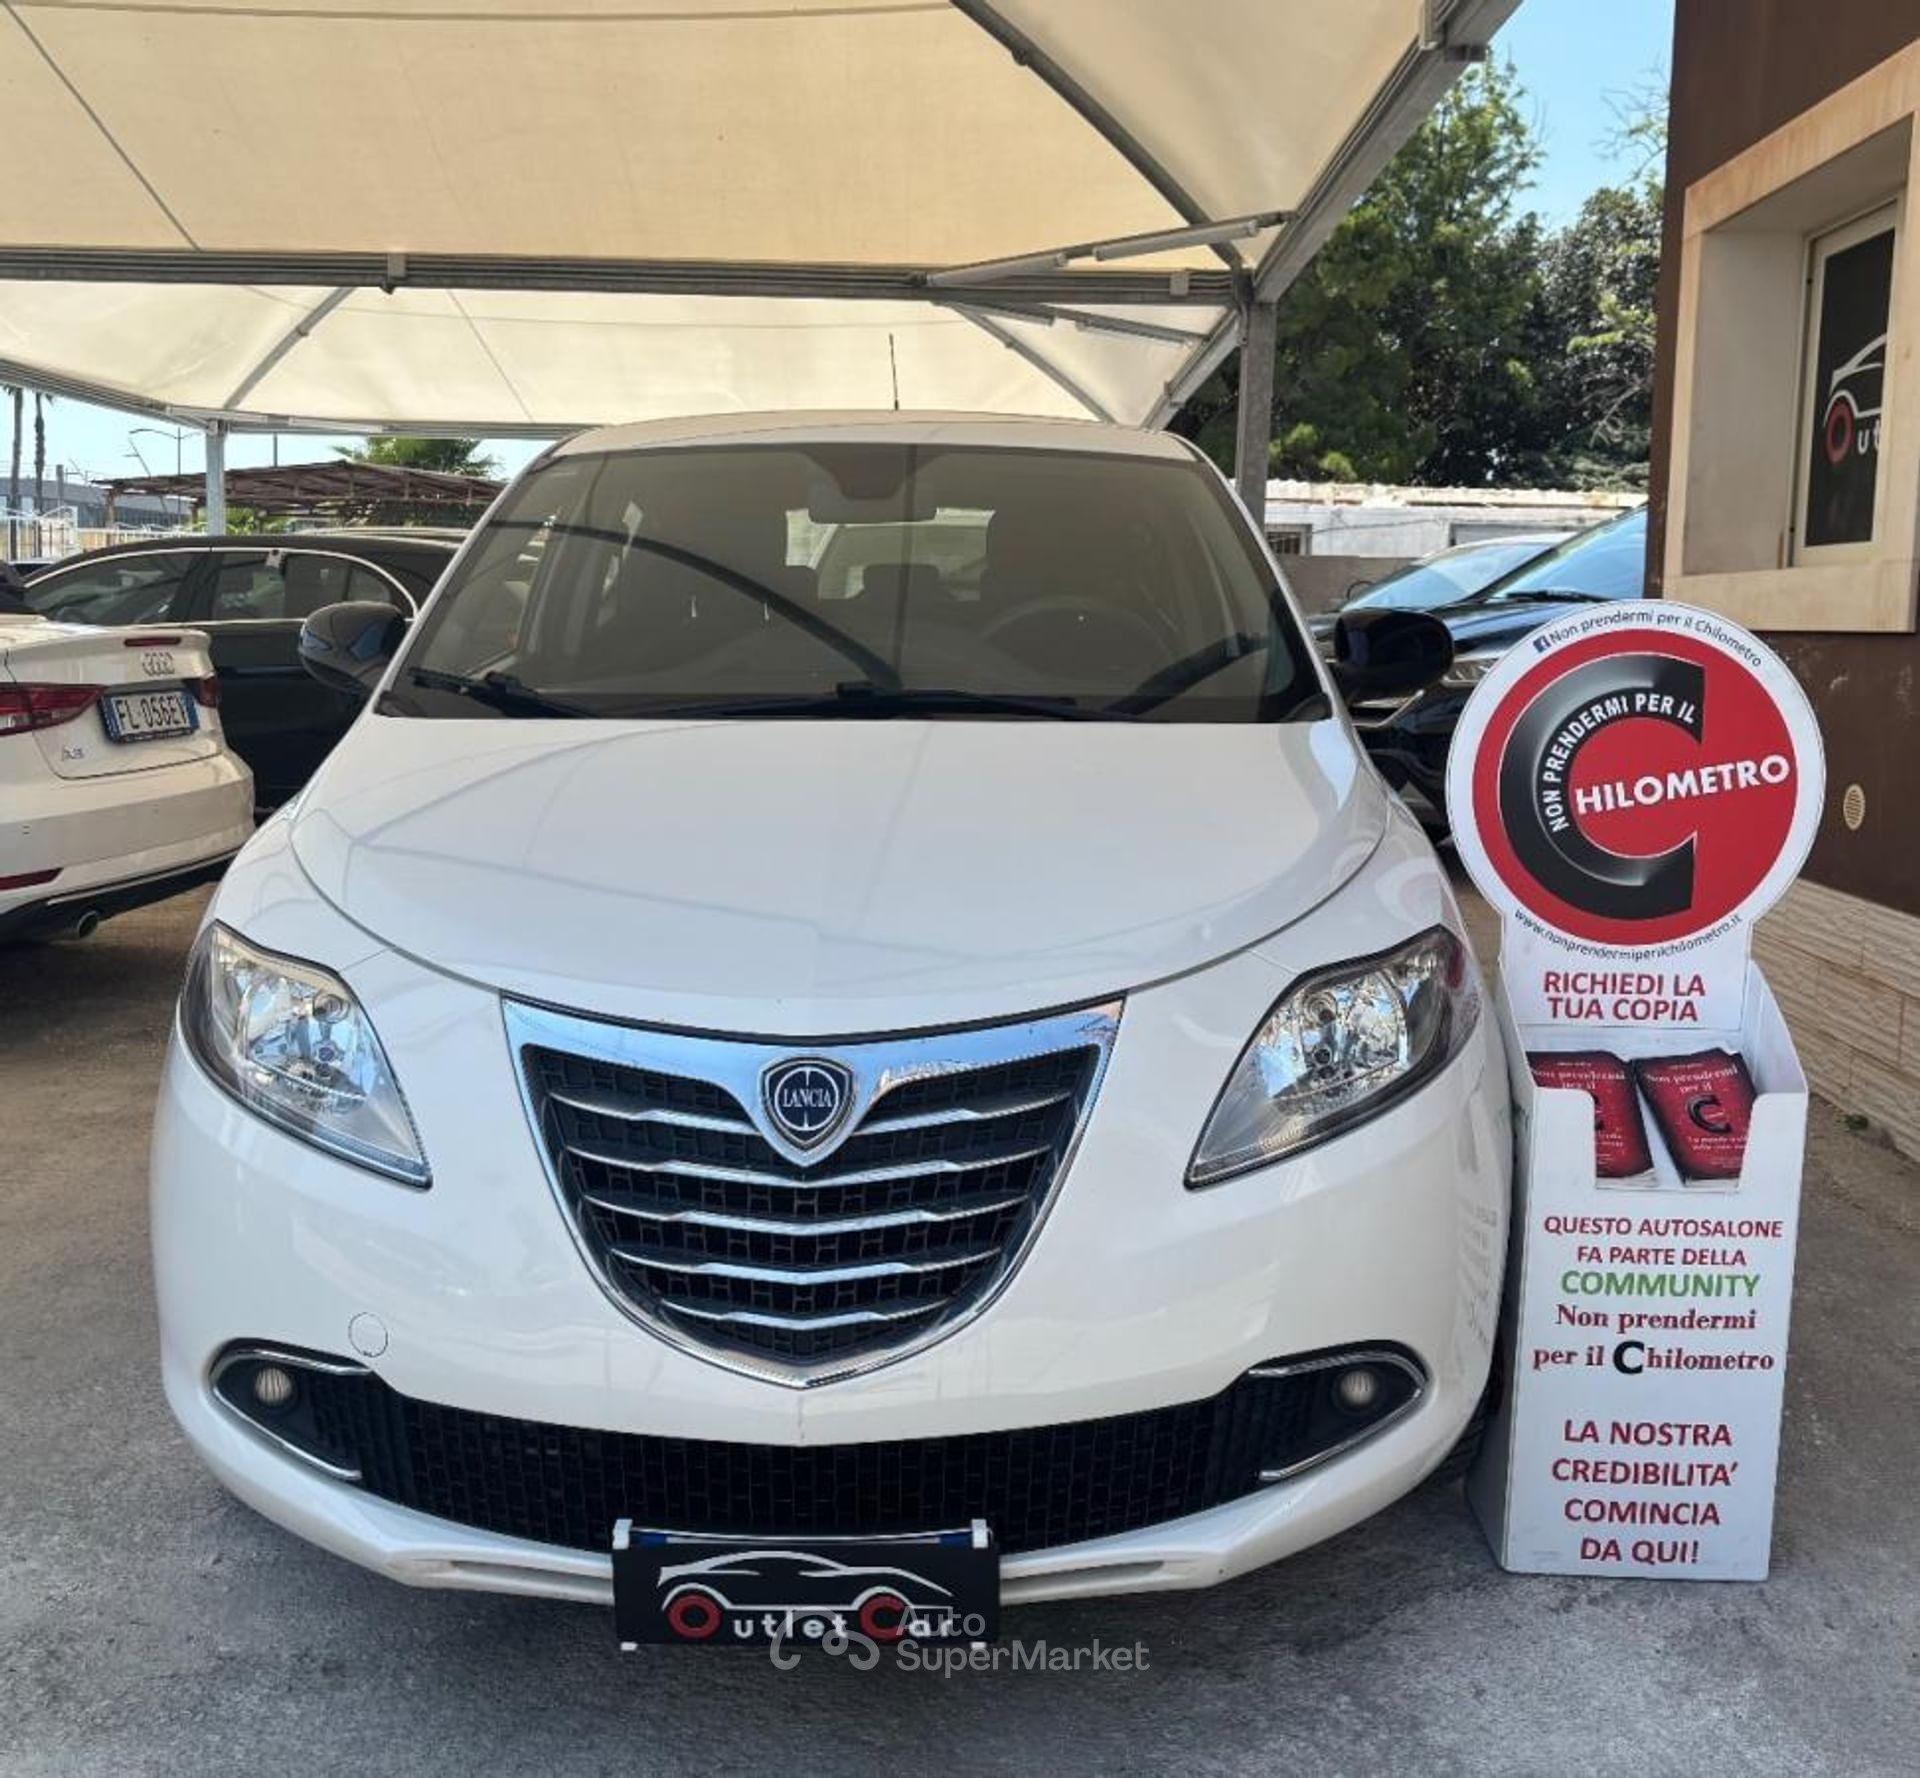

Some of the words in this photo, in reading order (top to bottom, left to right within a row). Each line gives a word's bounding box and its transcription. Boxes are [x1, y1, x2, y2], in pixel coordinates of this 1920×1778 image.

[1550, 626, 1585, 645] Non
[1581, 610, 1654, 633] prendermi
[1657, 613, 1680, 626] per
[1684, 616, 1694, 628] il
[1694, 619, 1762, 667] Chilometro
[114, 698, 141, 731] FL
[1635, 692, 1674, 716] PER
[1677, 701, 1696, 724] IL
[1543, 695, 1629, 783] PRENDERMI
[1543, 789, 1570, 833] NON
[1543, 971, 1665, 997] RICHIEDI
[1673, 974, 1706, 997] LA
[1547, 997, 1604, 1020] TUA
[1612, 999, 1699, 1022] COPIA
[782, 1087, 832, 1108] LANCIA
[1543, 1215, 1632, 1236] QUESTO
[1637, 1218, 1783, 1239] AUTOSALONE
[1577, 1245, 1604, 1264] FA
[1609, 1246, 1676, 1266] PARTE
[1681, 1247, 1747, 1267] DELLA
[1560, 1270, 1761, 1298] COMMUNITY
[1555, 1303, 1609, 1328] Non
[1616, 1308, 1757, 1335] prendermi
[1533, 1347, 1579, 1371] per
[1585, 1344, 1604, 1368] il
[1612, 1339, 1775, 1375] Chilometro
[1563, 1419, 1600, 1443] LA
[1609, 1420, 1733, 1447] NOSTRA
[1563, 1498, 1720, 1526] COMINCIA
[1580, 1538, 1623, 1562] DA
[1631, 1539, 1700, 1566] QUI!
[667, 1592, 850, 1641] Outlet
